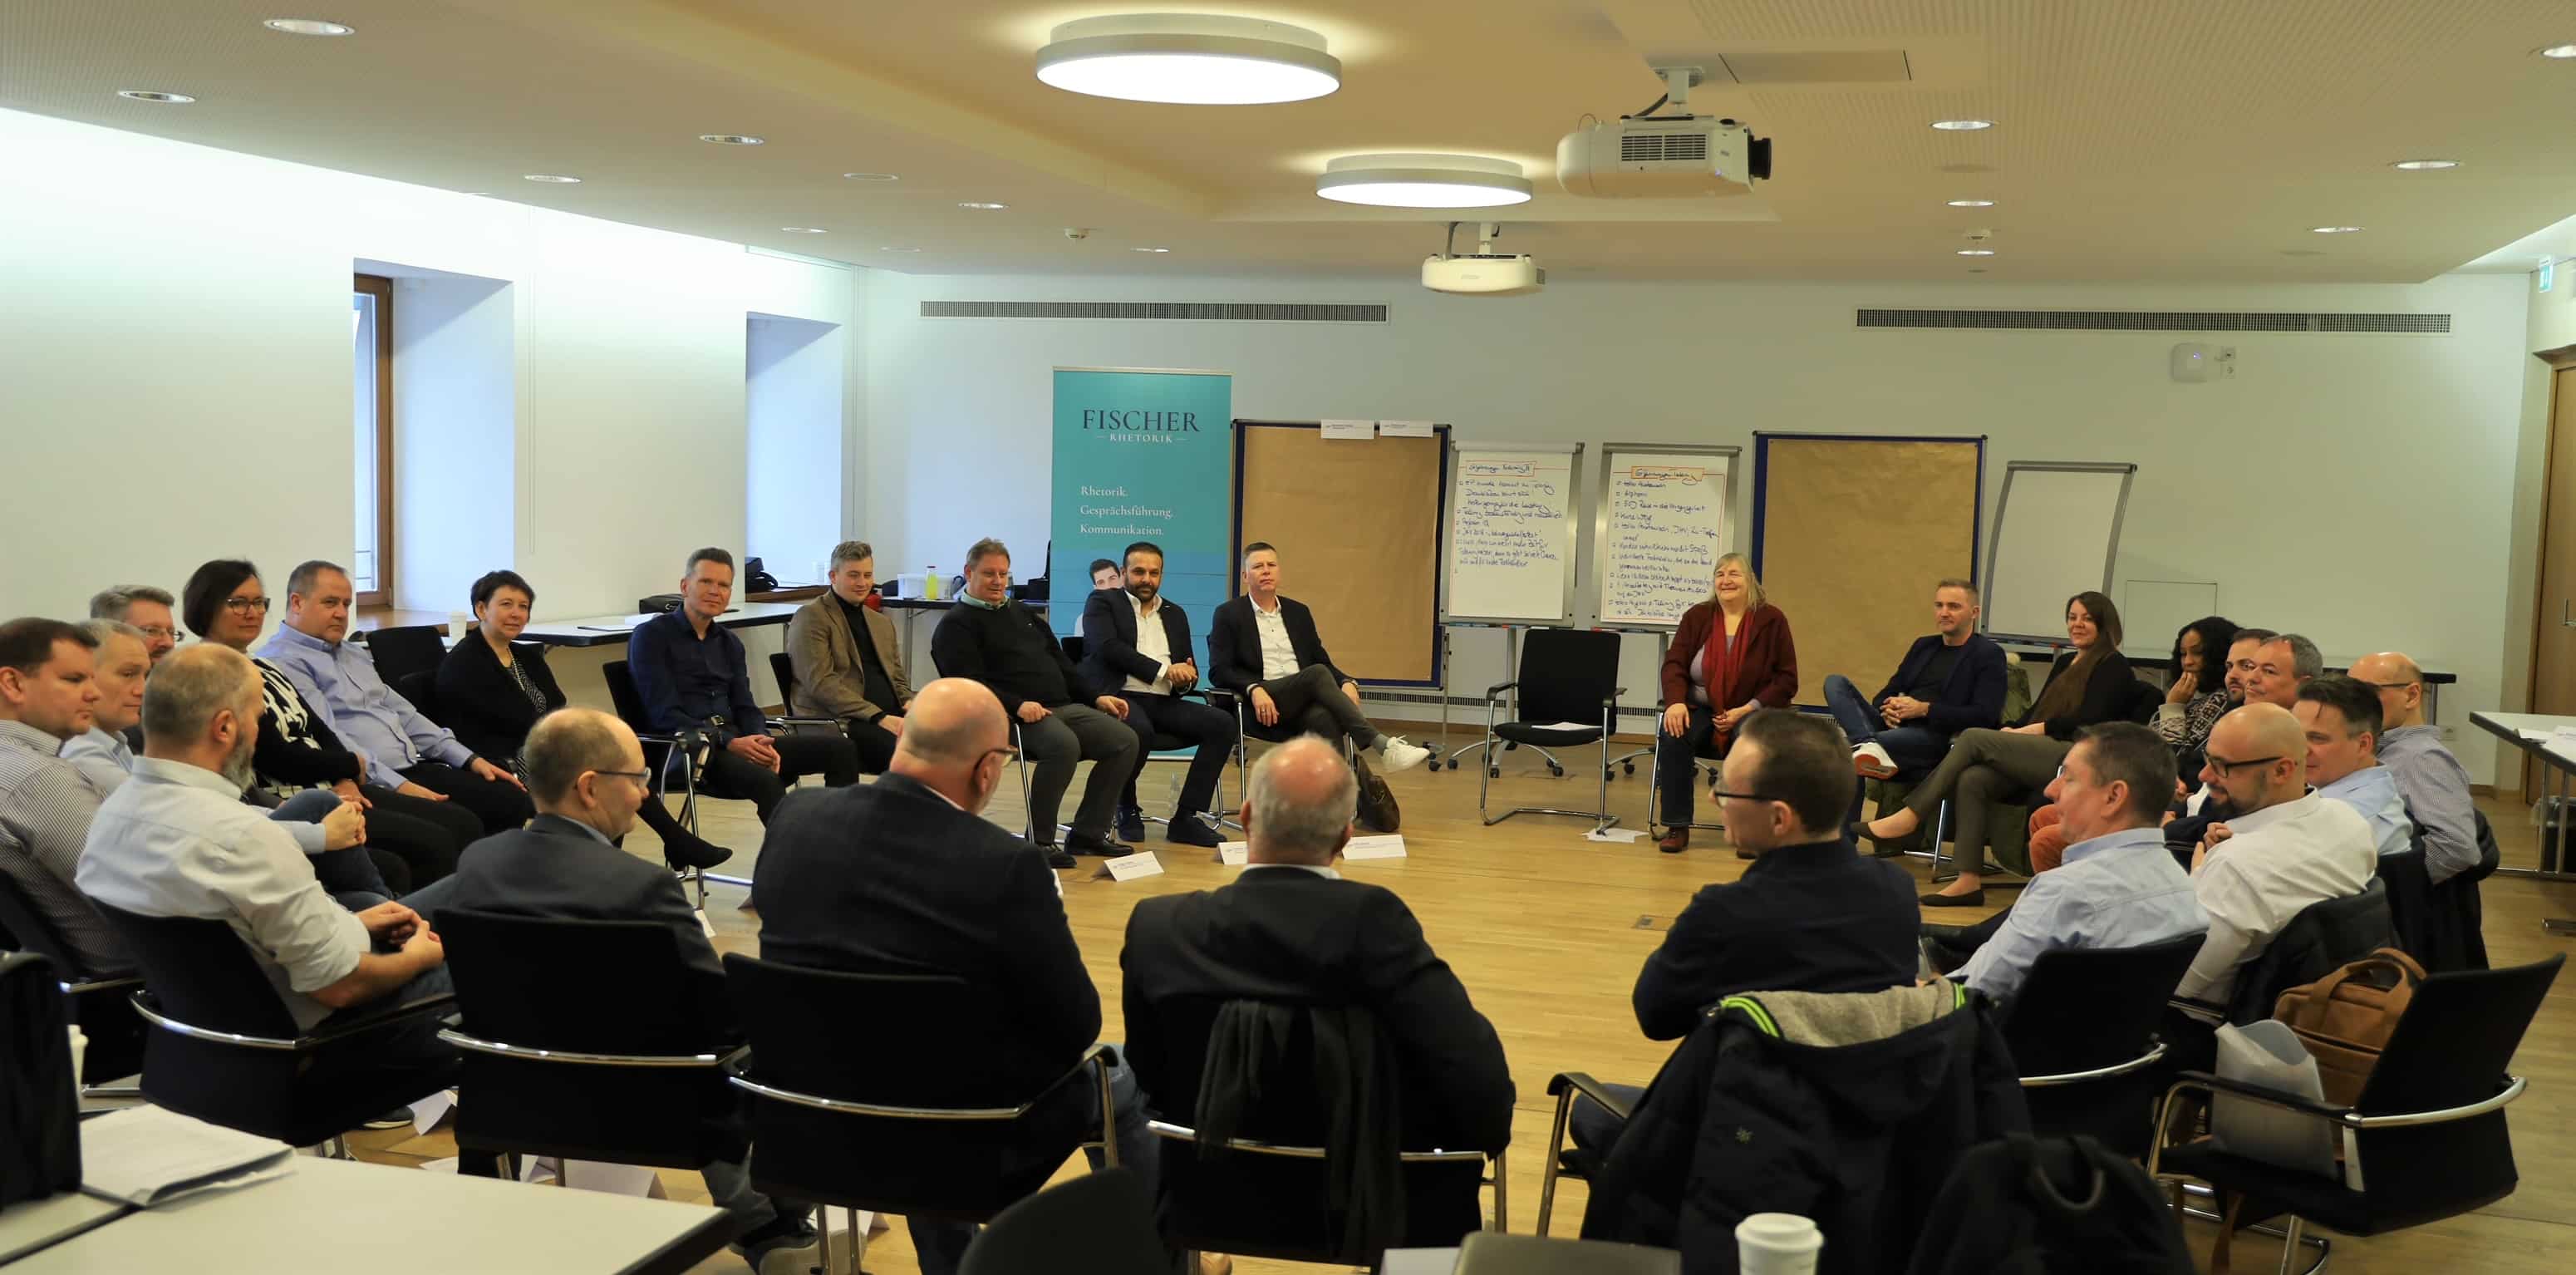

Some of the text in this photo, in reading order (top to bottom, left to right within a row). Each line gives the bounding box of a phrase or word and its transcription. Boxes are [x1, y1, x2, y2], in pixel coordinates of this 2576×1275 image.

[1083, 409, 1201, 431] FISCHER
[1109, 433, 1172, 443] RHETORIK
[1080, 524, 1164, 535] Kommunikation.
